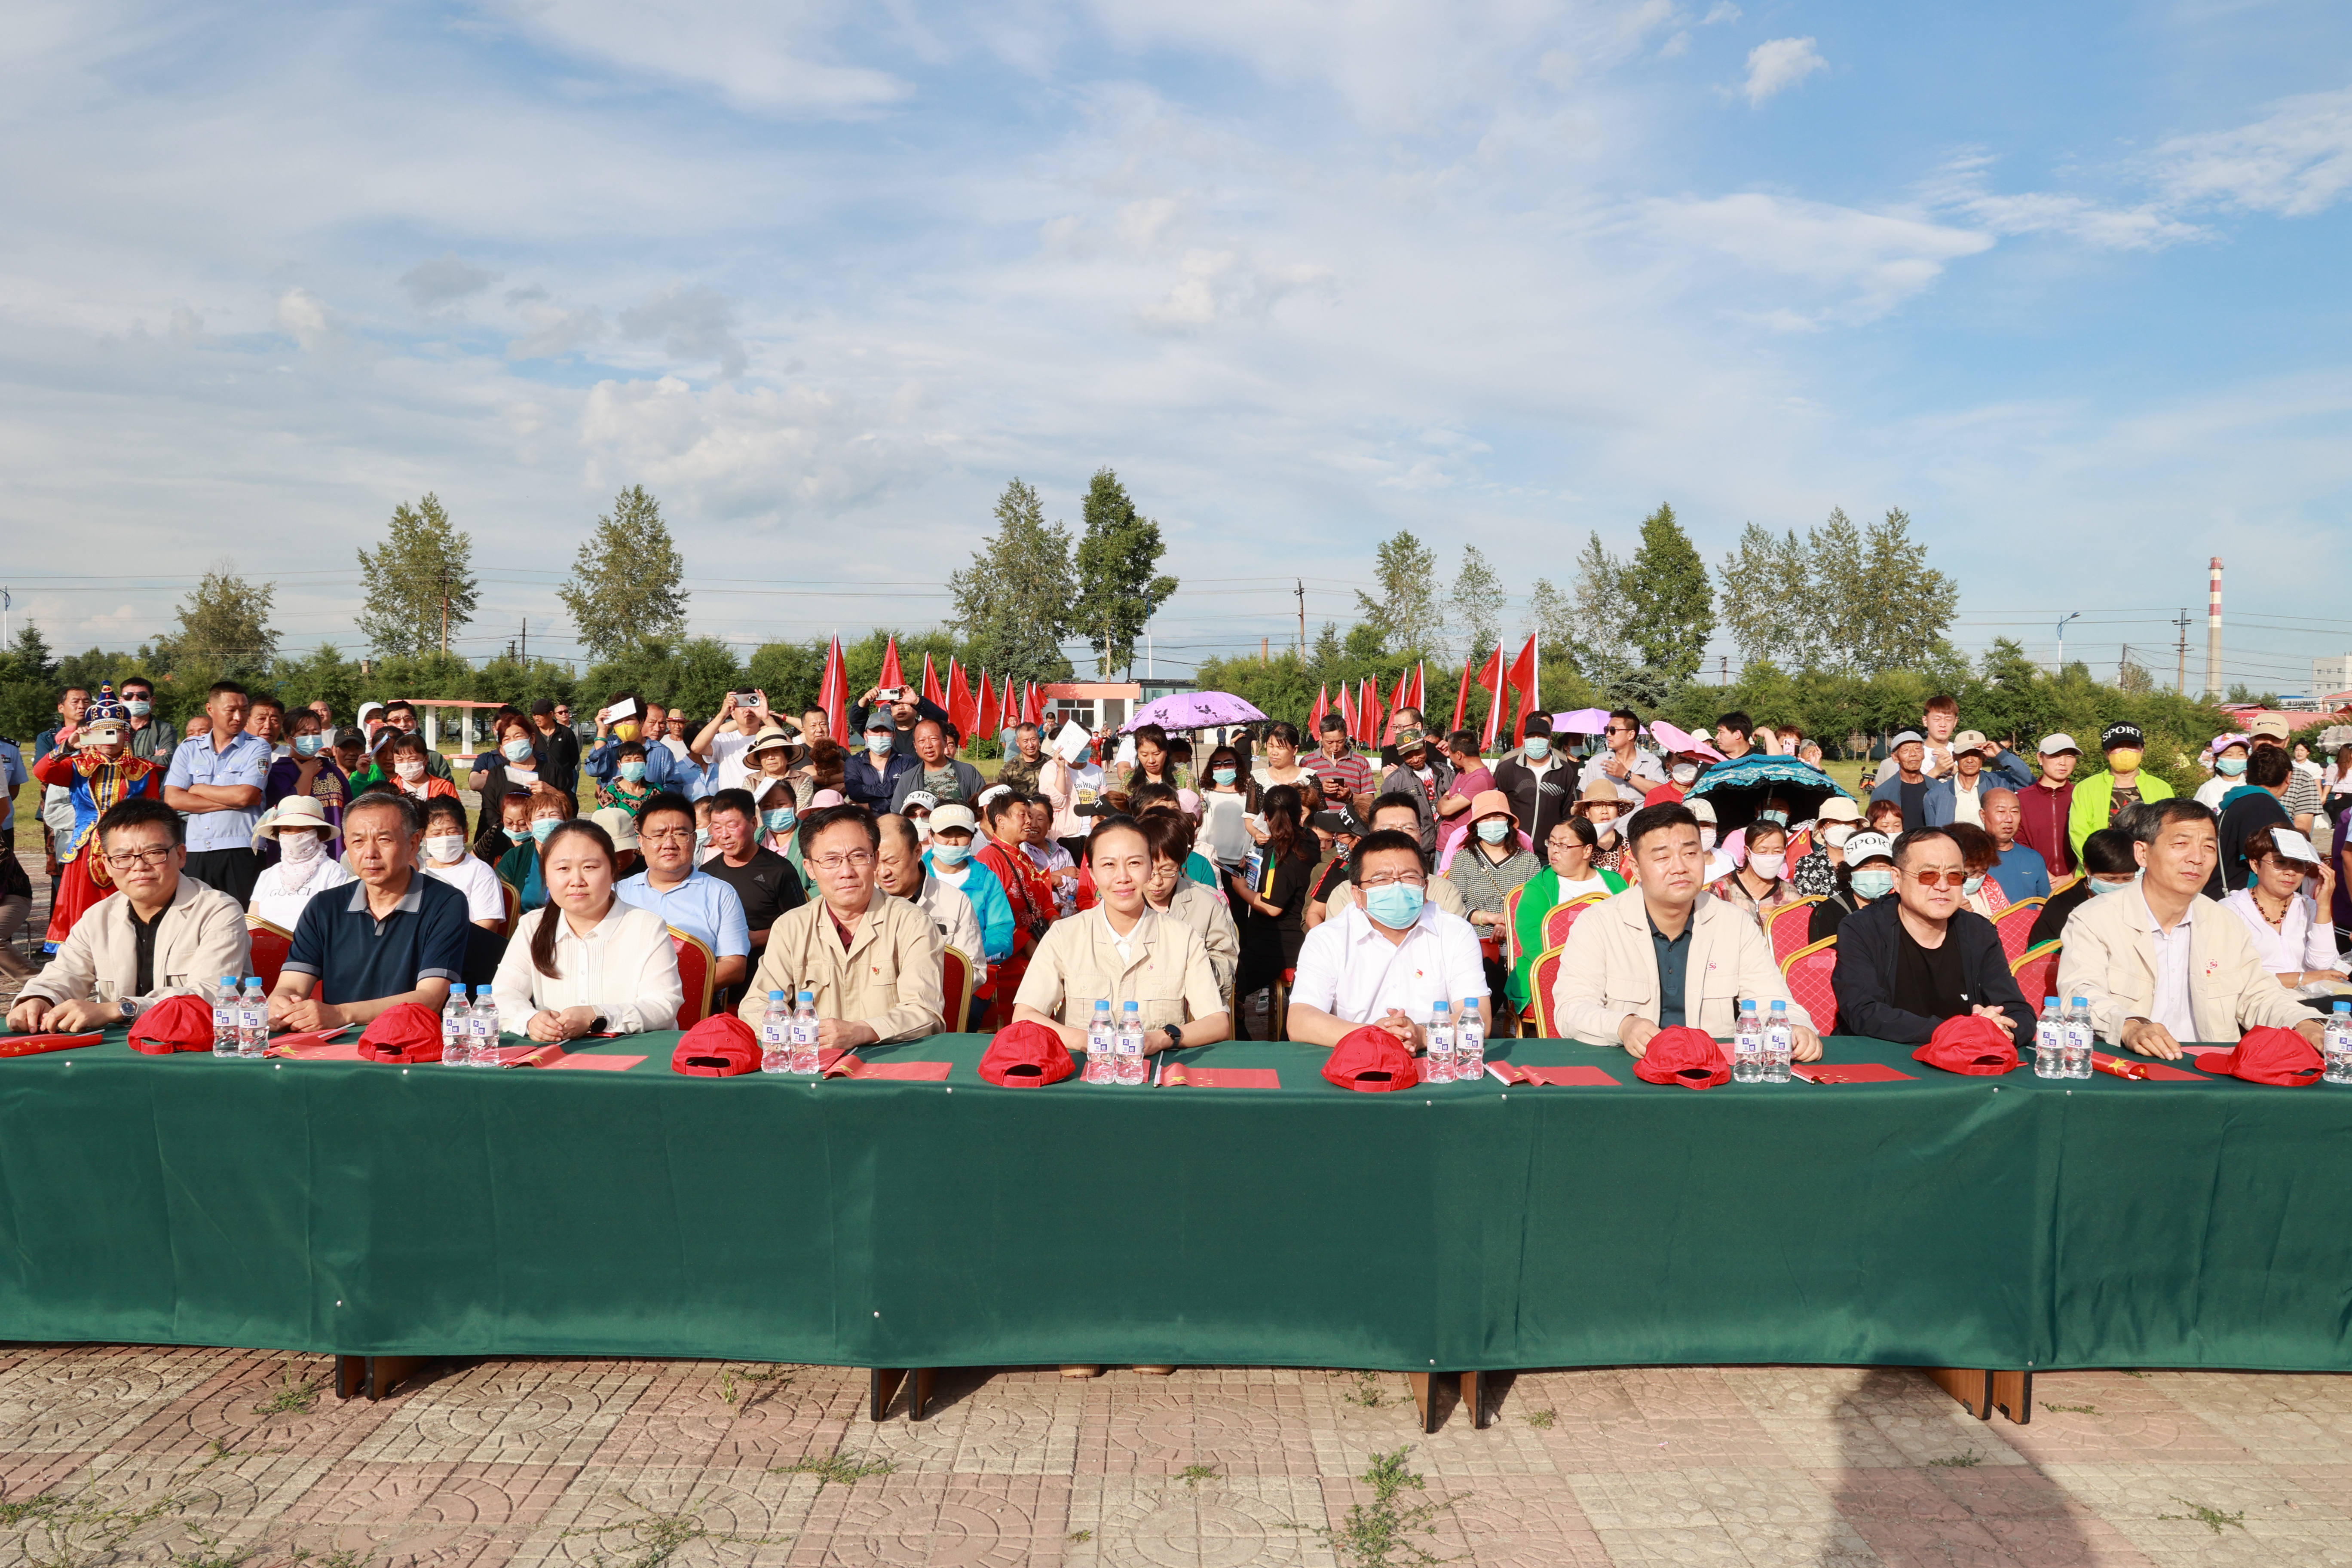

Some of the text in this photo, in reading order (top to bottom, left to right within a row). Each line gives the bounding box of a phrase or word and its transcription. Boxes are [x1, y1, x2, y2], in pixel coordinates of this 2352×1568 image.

[2102, 726, 2141, 742] SPORT
[932, 808, 971, 820] SPORT
[1847, 837, 1892, 854] SPORT
